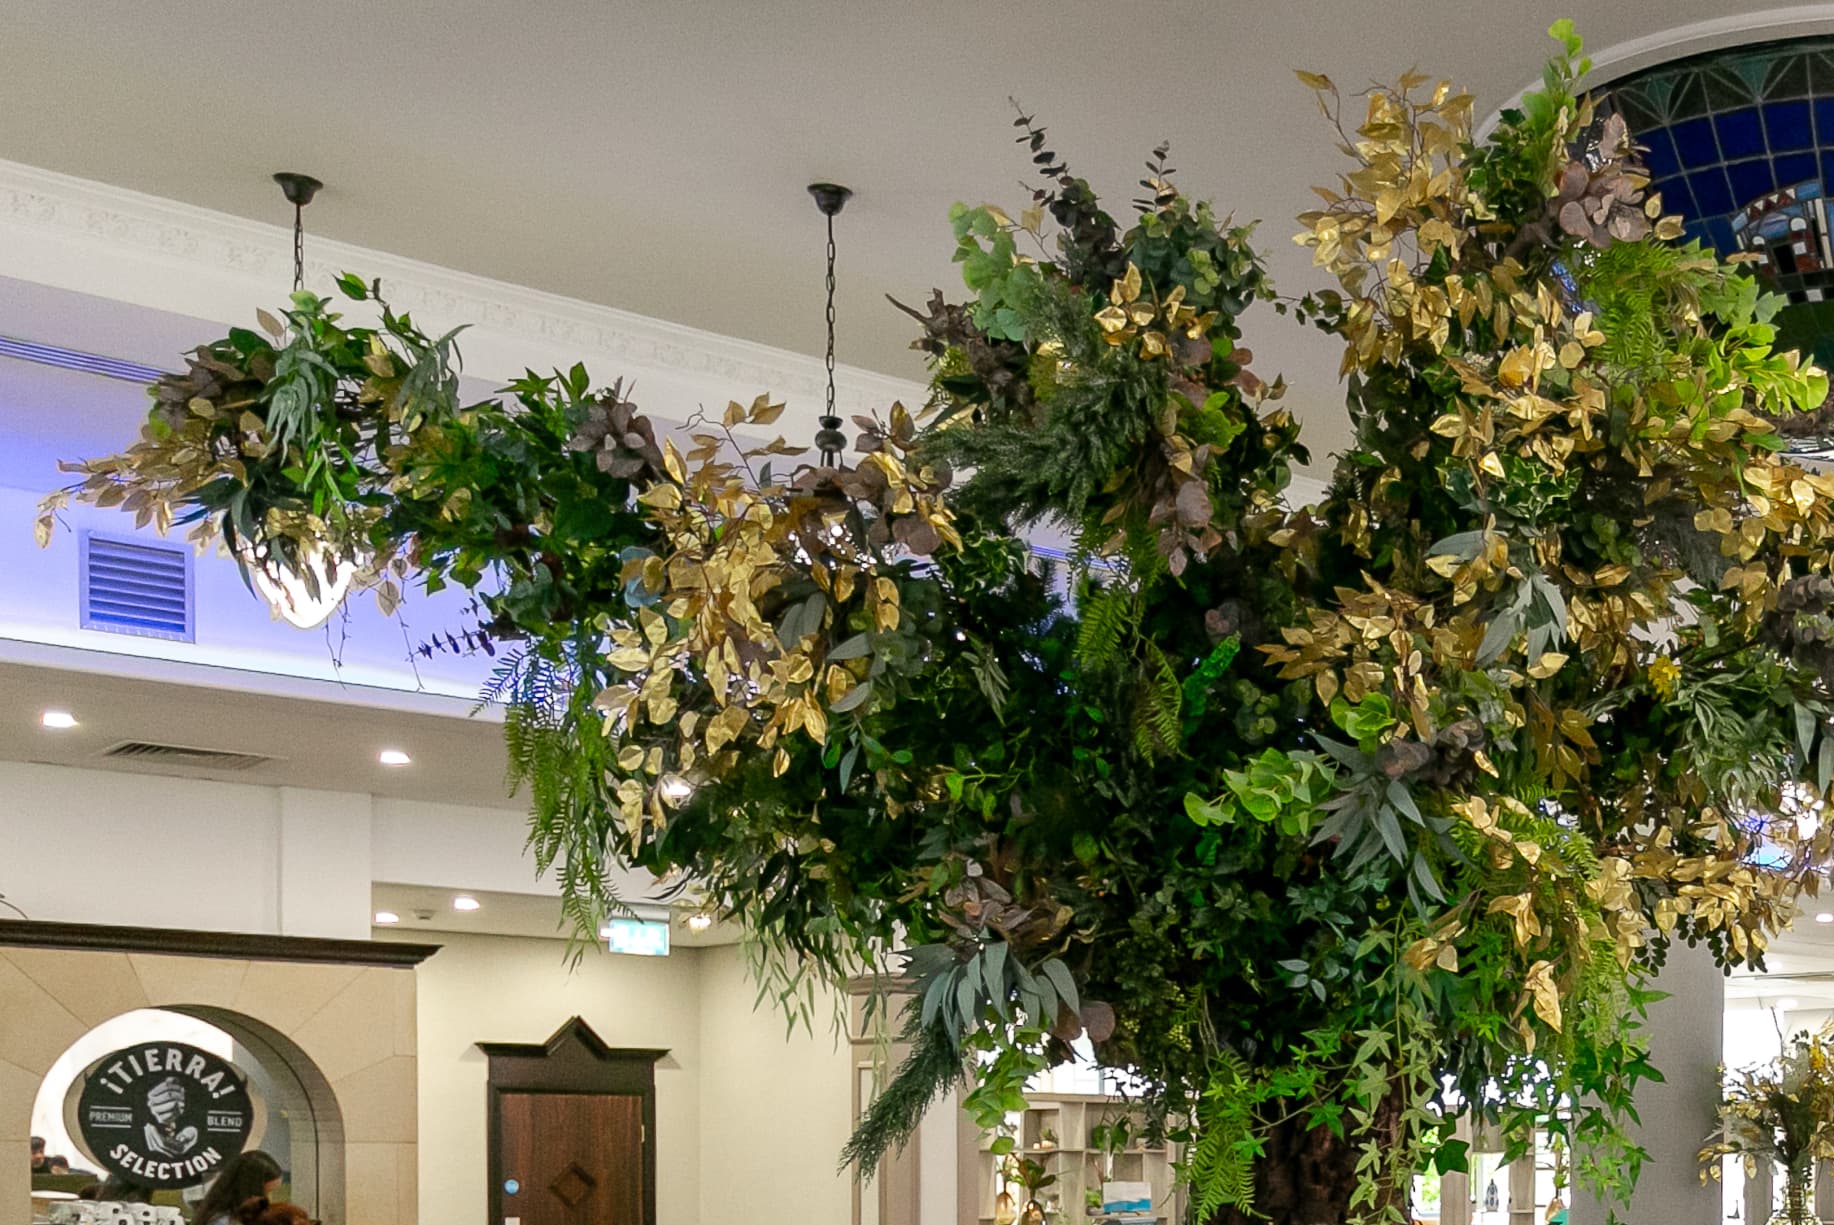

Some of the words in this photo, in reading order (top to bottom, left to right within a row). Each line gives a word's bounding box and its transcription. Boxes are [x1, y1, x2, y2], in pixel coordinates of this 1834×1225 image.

[89, 1111, 133, 1122] PREMIUM
[207, 1115, 243, 1127] BLEND
[110, 1144, 222, 1180] SELECTION
